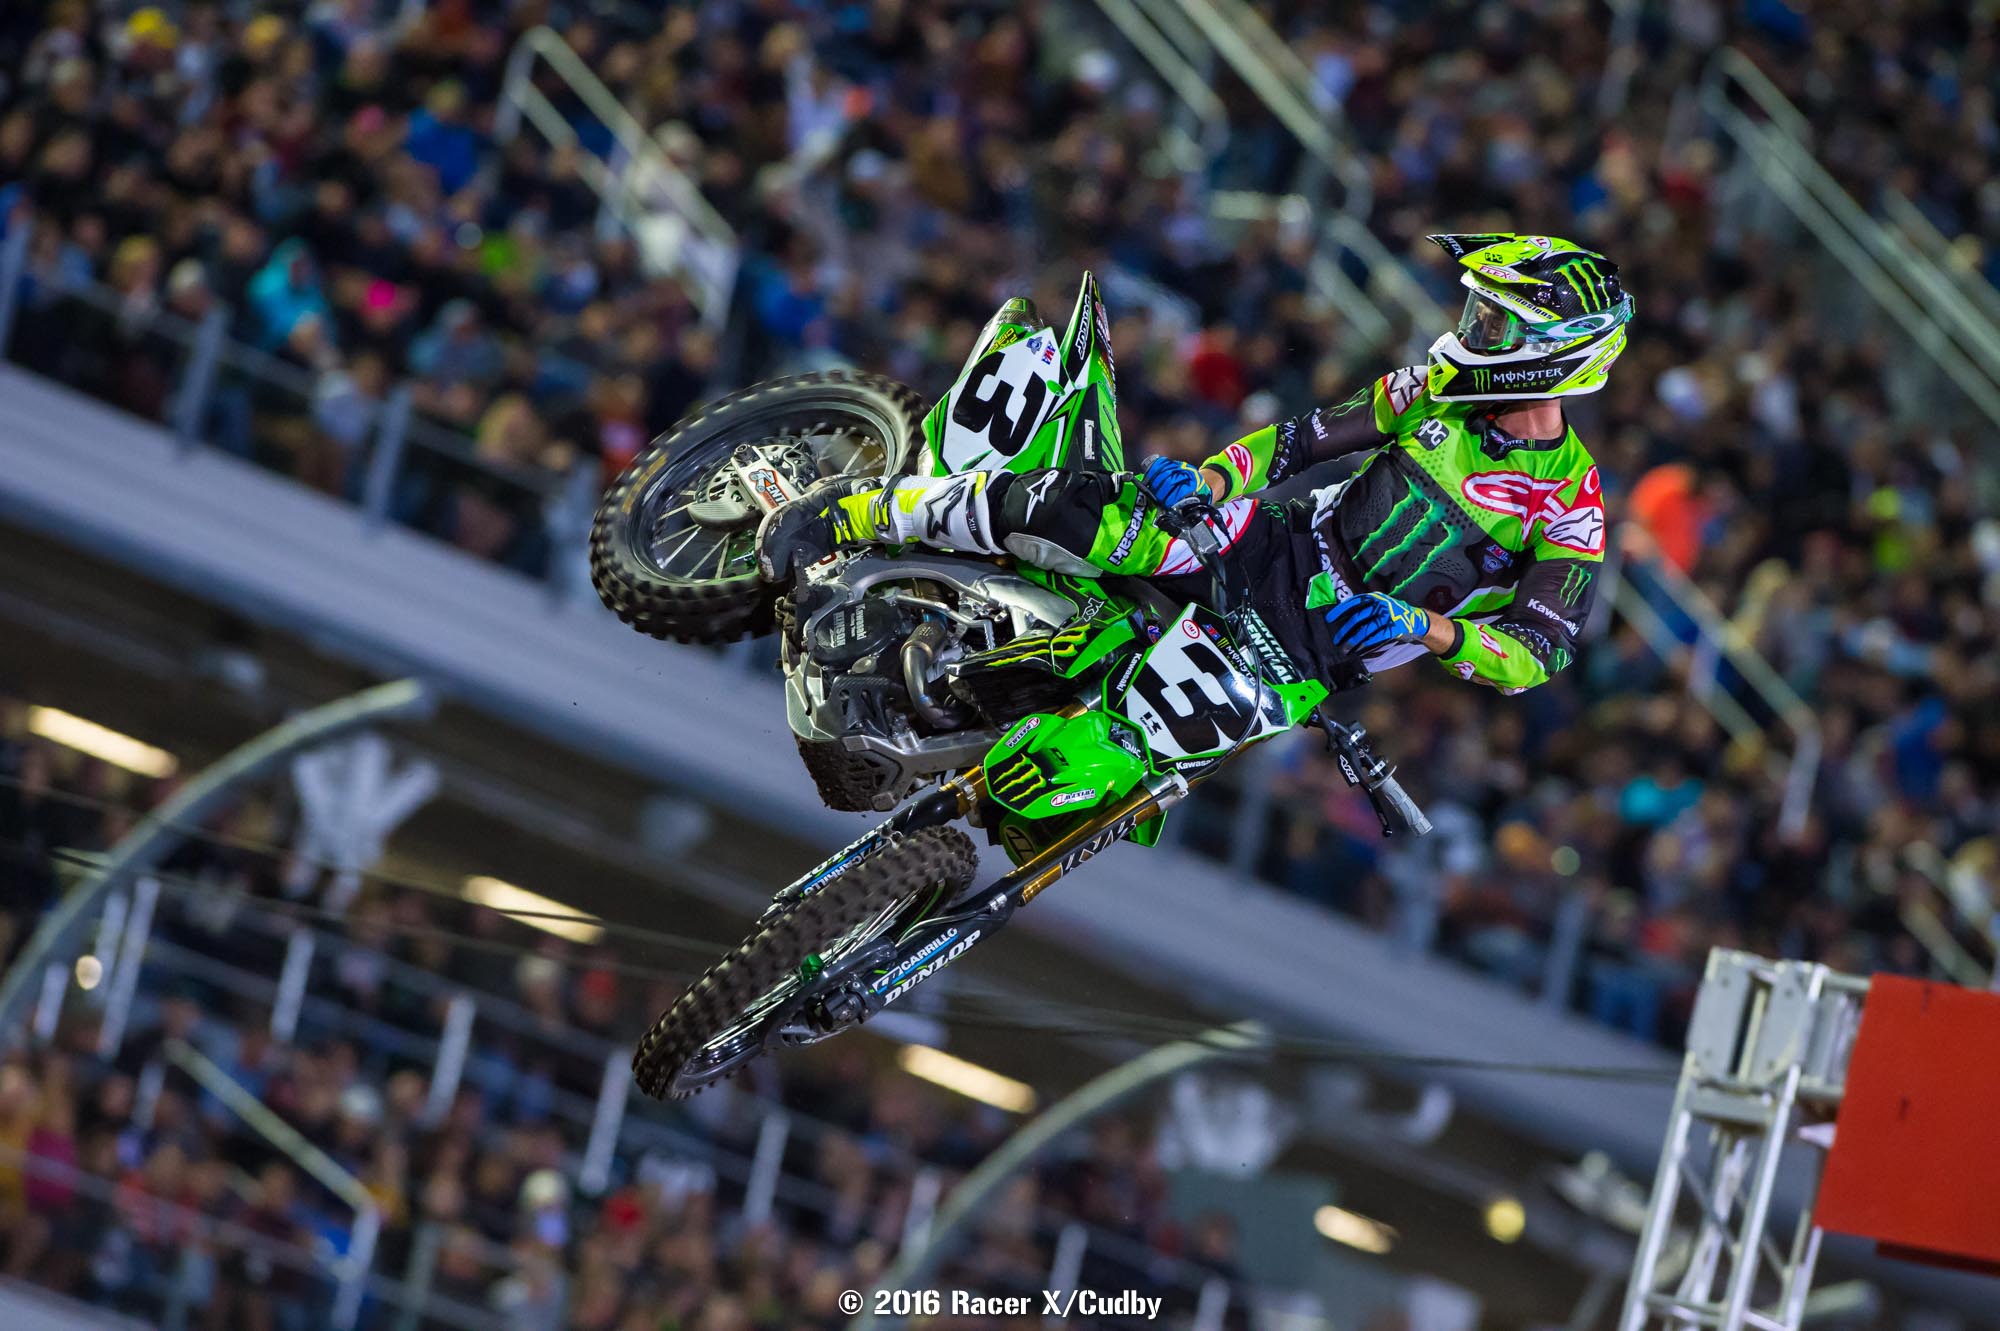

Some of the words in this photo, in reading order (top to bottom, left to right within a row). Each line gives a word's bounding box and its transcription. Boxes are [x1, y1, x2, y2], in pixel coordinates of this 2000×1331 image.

[1493, 367, 1563, 384] MONSTER
[953, 351, 1047, 457] 3
[1108, 491, 1145, 566] awasaki
[856, 604, 867, 640] Kawasaki
[1116, 652, 1142, 692] Kawasaki
[1226, 645, 1257, 686] MONSTE
[1132, 642, 1262, 754] 3
[1121, 738, 1142, 759] TOMAC
[1175, 758, 1214, 771] Kawasa
[883, 929, 981, 1006] DUNLOP
[901, 927, 958, 971] CARRILLO
